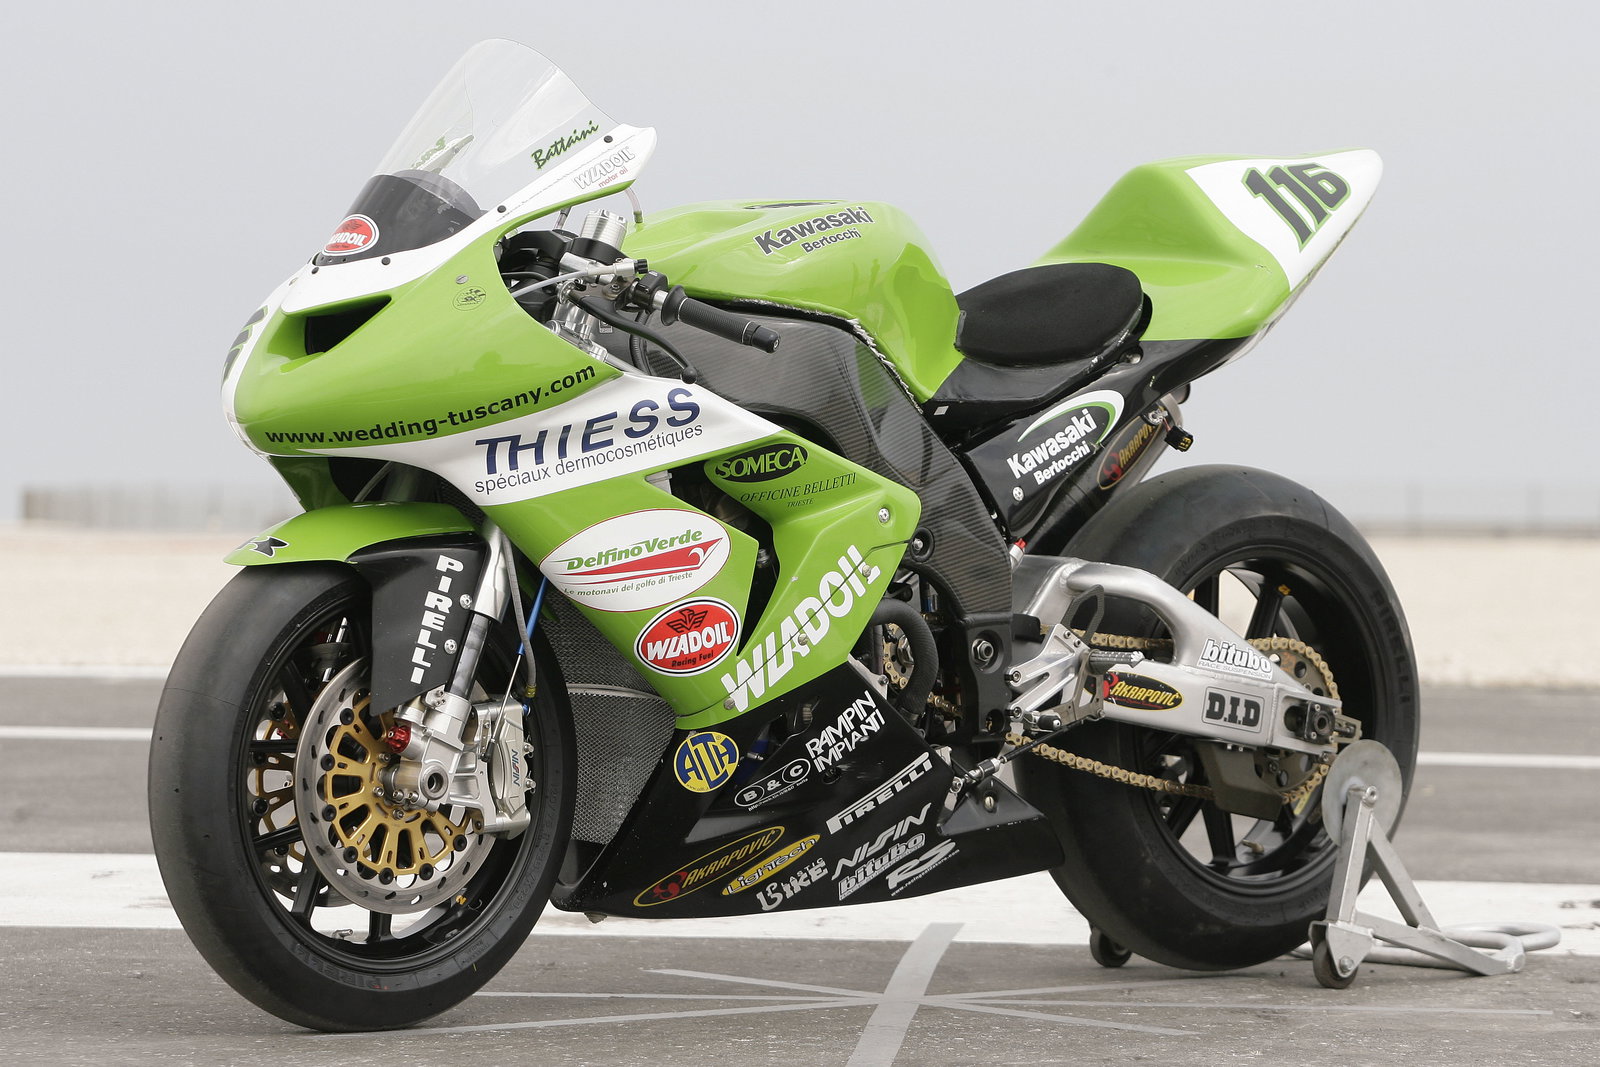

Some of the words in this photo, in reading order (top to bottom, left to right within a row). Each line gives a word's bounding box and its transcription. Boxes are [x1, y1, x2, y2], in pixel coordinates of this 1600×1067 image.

[531, 120, 599, 169] Battaini
[598, 173, 619, 188] motor
[619, 166, 629, 176] oil
[754, 206, 874, 254] Kawasaki
[1243, 163, 1350, 249] 116
[801, 228, 862, 253] Bertocchi
[265, 365, 596, 443] www.wedding-tuscany.com
[475, 388, 700, 475] THIESS
[1007, 408, 1098, 479] Kawasaki
[475, 467, 551, 494] spéciaux
[555, 424, 703, 476] dermocosmétiques
[716, 446, 805, 479] SOMECA
[1033, 441, 1090, 485] Bertocchi
[741, 486, 801, 502] OFFICINE
[804, 472, 856, 495] BELLETTI
[787, 498, 815, 508] TRIESTE
[577, 587, 619, 596] motonavi
[621, 583, 634, 592] del
[635, 578, 656, 591] golfo
[658, 575, 667, 584] di
[668, 572, 693, 582] Trieste
[410, 554, 464, 685] PIRELLI
[647, 621, 731, 660] WLADOIL
[720, 544, 881, 713] WLADOIL
[672, 656, 697, 667] Racing
[699, 650, 714, 662] Fuel
[1200, 661, 1221, 669] RACE
[1223, 665, 1271, 679] SUSPENSION
[1201, 638, 1272, 673] bitubo
[805, 690, 876, 759] RAMPIN
[813, 709, 886, 773] IMPIANTI
[825, 751, 933, 835] PIRELLI
[840, 833, 925, 895] bitubo
